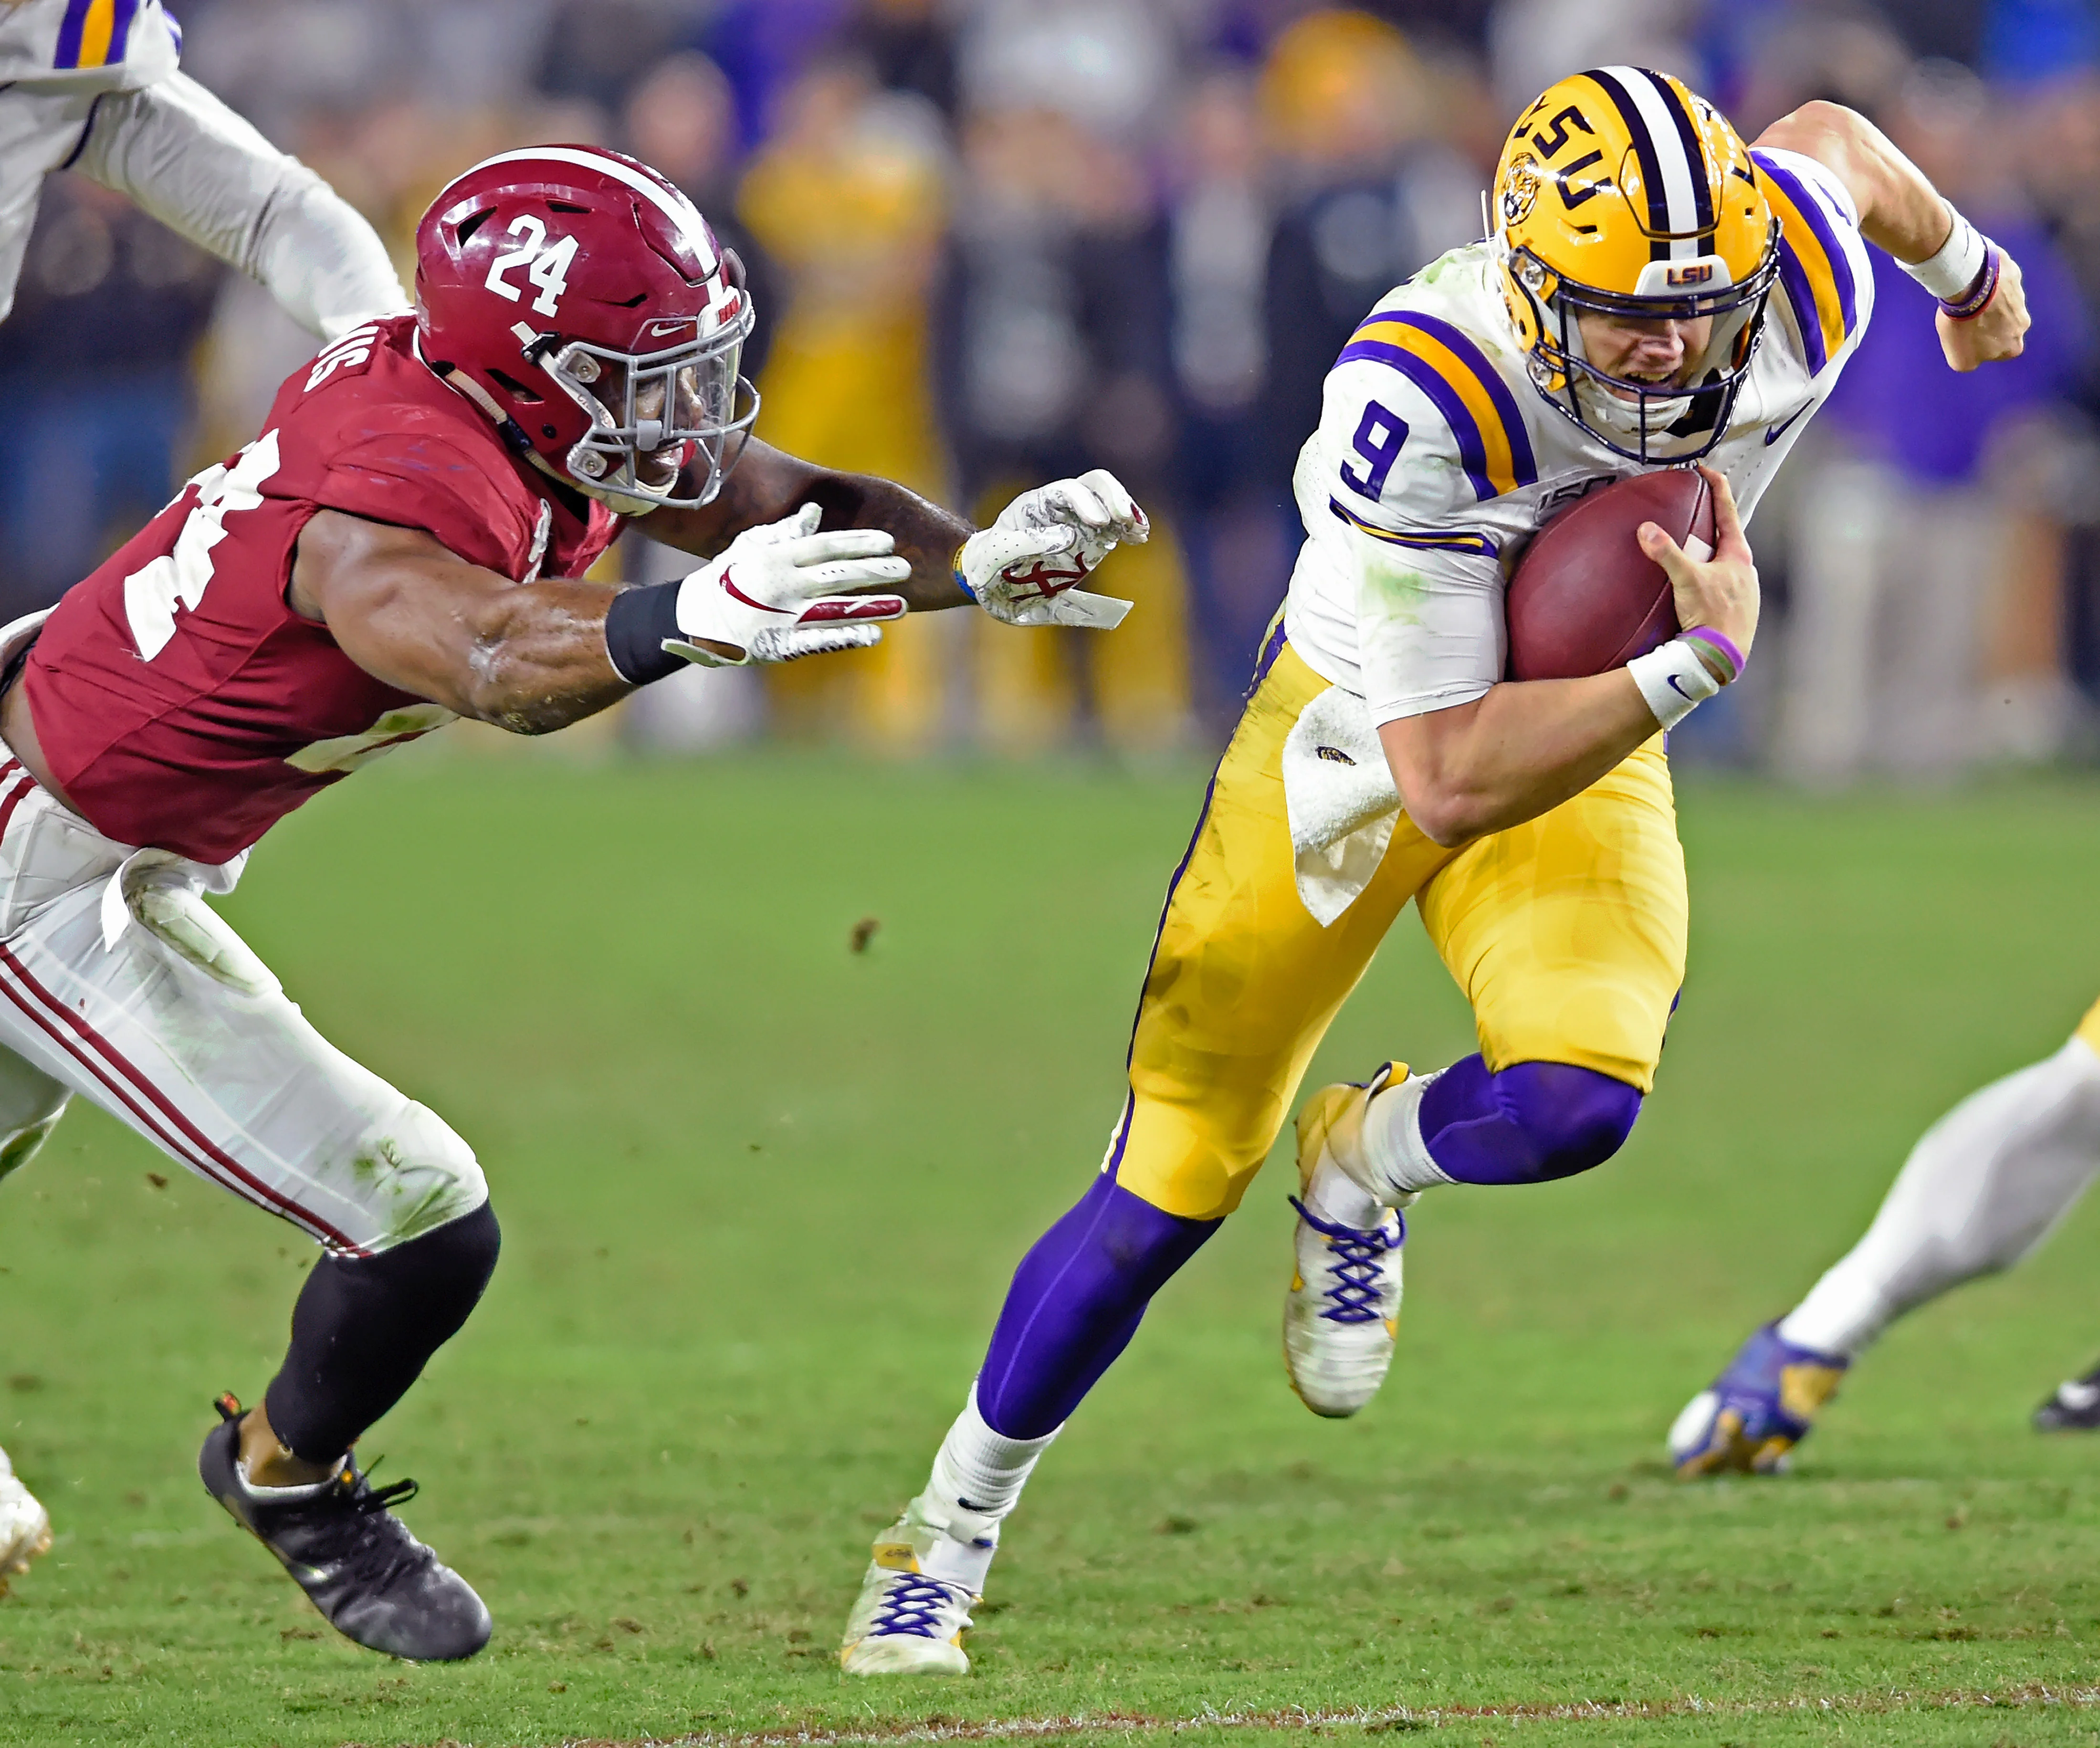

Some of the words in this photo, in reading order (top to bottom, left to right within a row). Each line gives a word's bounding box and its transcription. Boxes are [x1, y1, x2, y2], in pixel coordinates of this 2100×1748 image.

[484, 214, 579, 318] 24
[1667, 264, 1712, 286] LSU
[1340, 399, 1409, 502] 9
